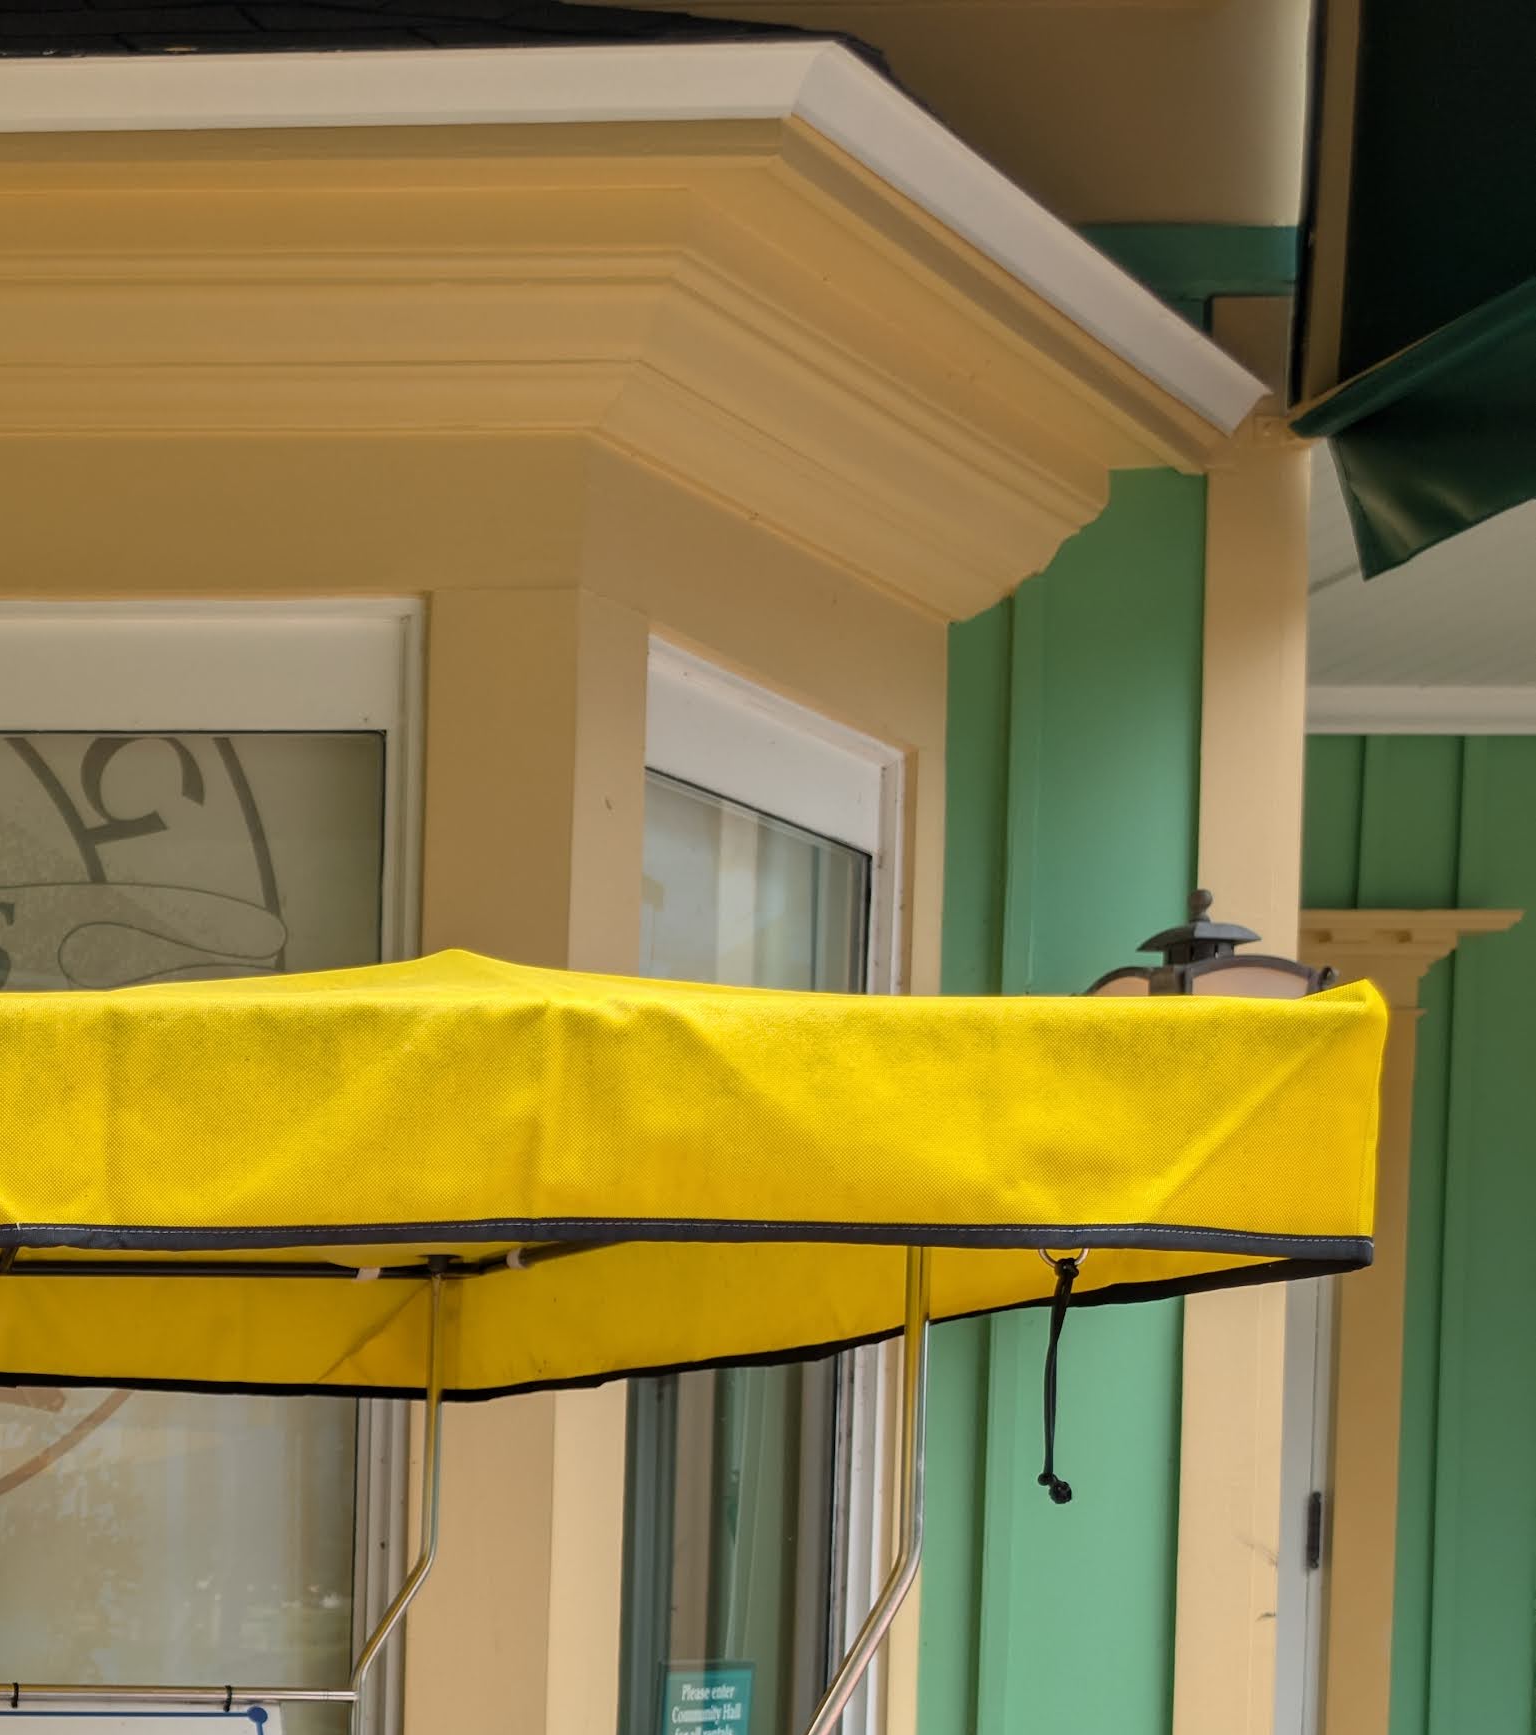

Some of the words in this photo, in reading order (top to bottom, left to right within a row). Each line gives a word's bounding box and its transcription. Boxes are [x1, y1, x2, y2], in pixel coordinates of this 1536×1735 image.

[682, 1684, 710, 1701] Please
[711, 1684, 735, 1700] enter
[671, 1705, 722, 1725] Community
[722, 1703, 742, 1720] Hall
